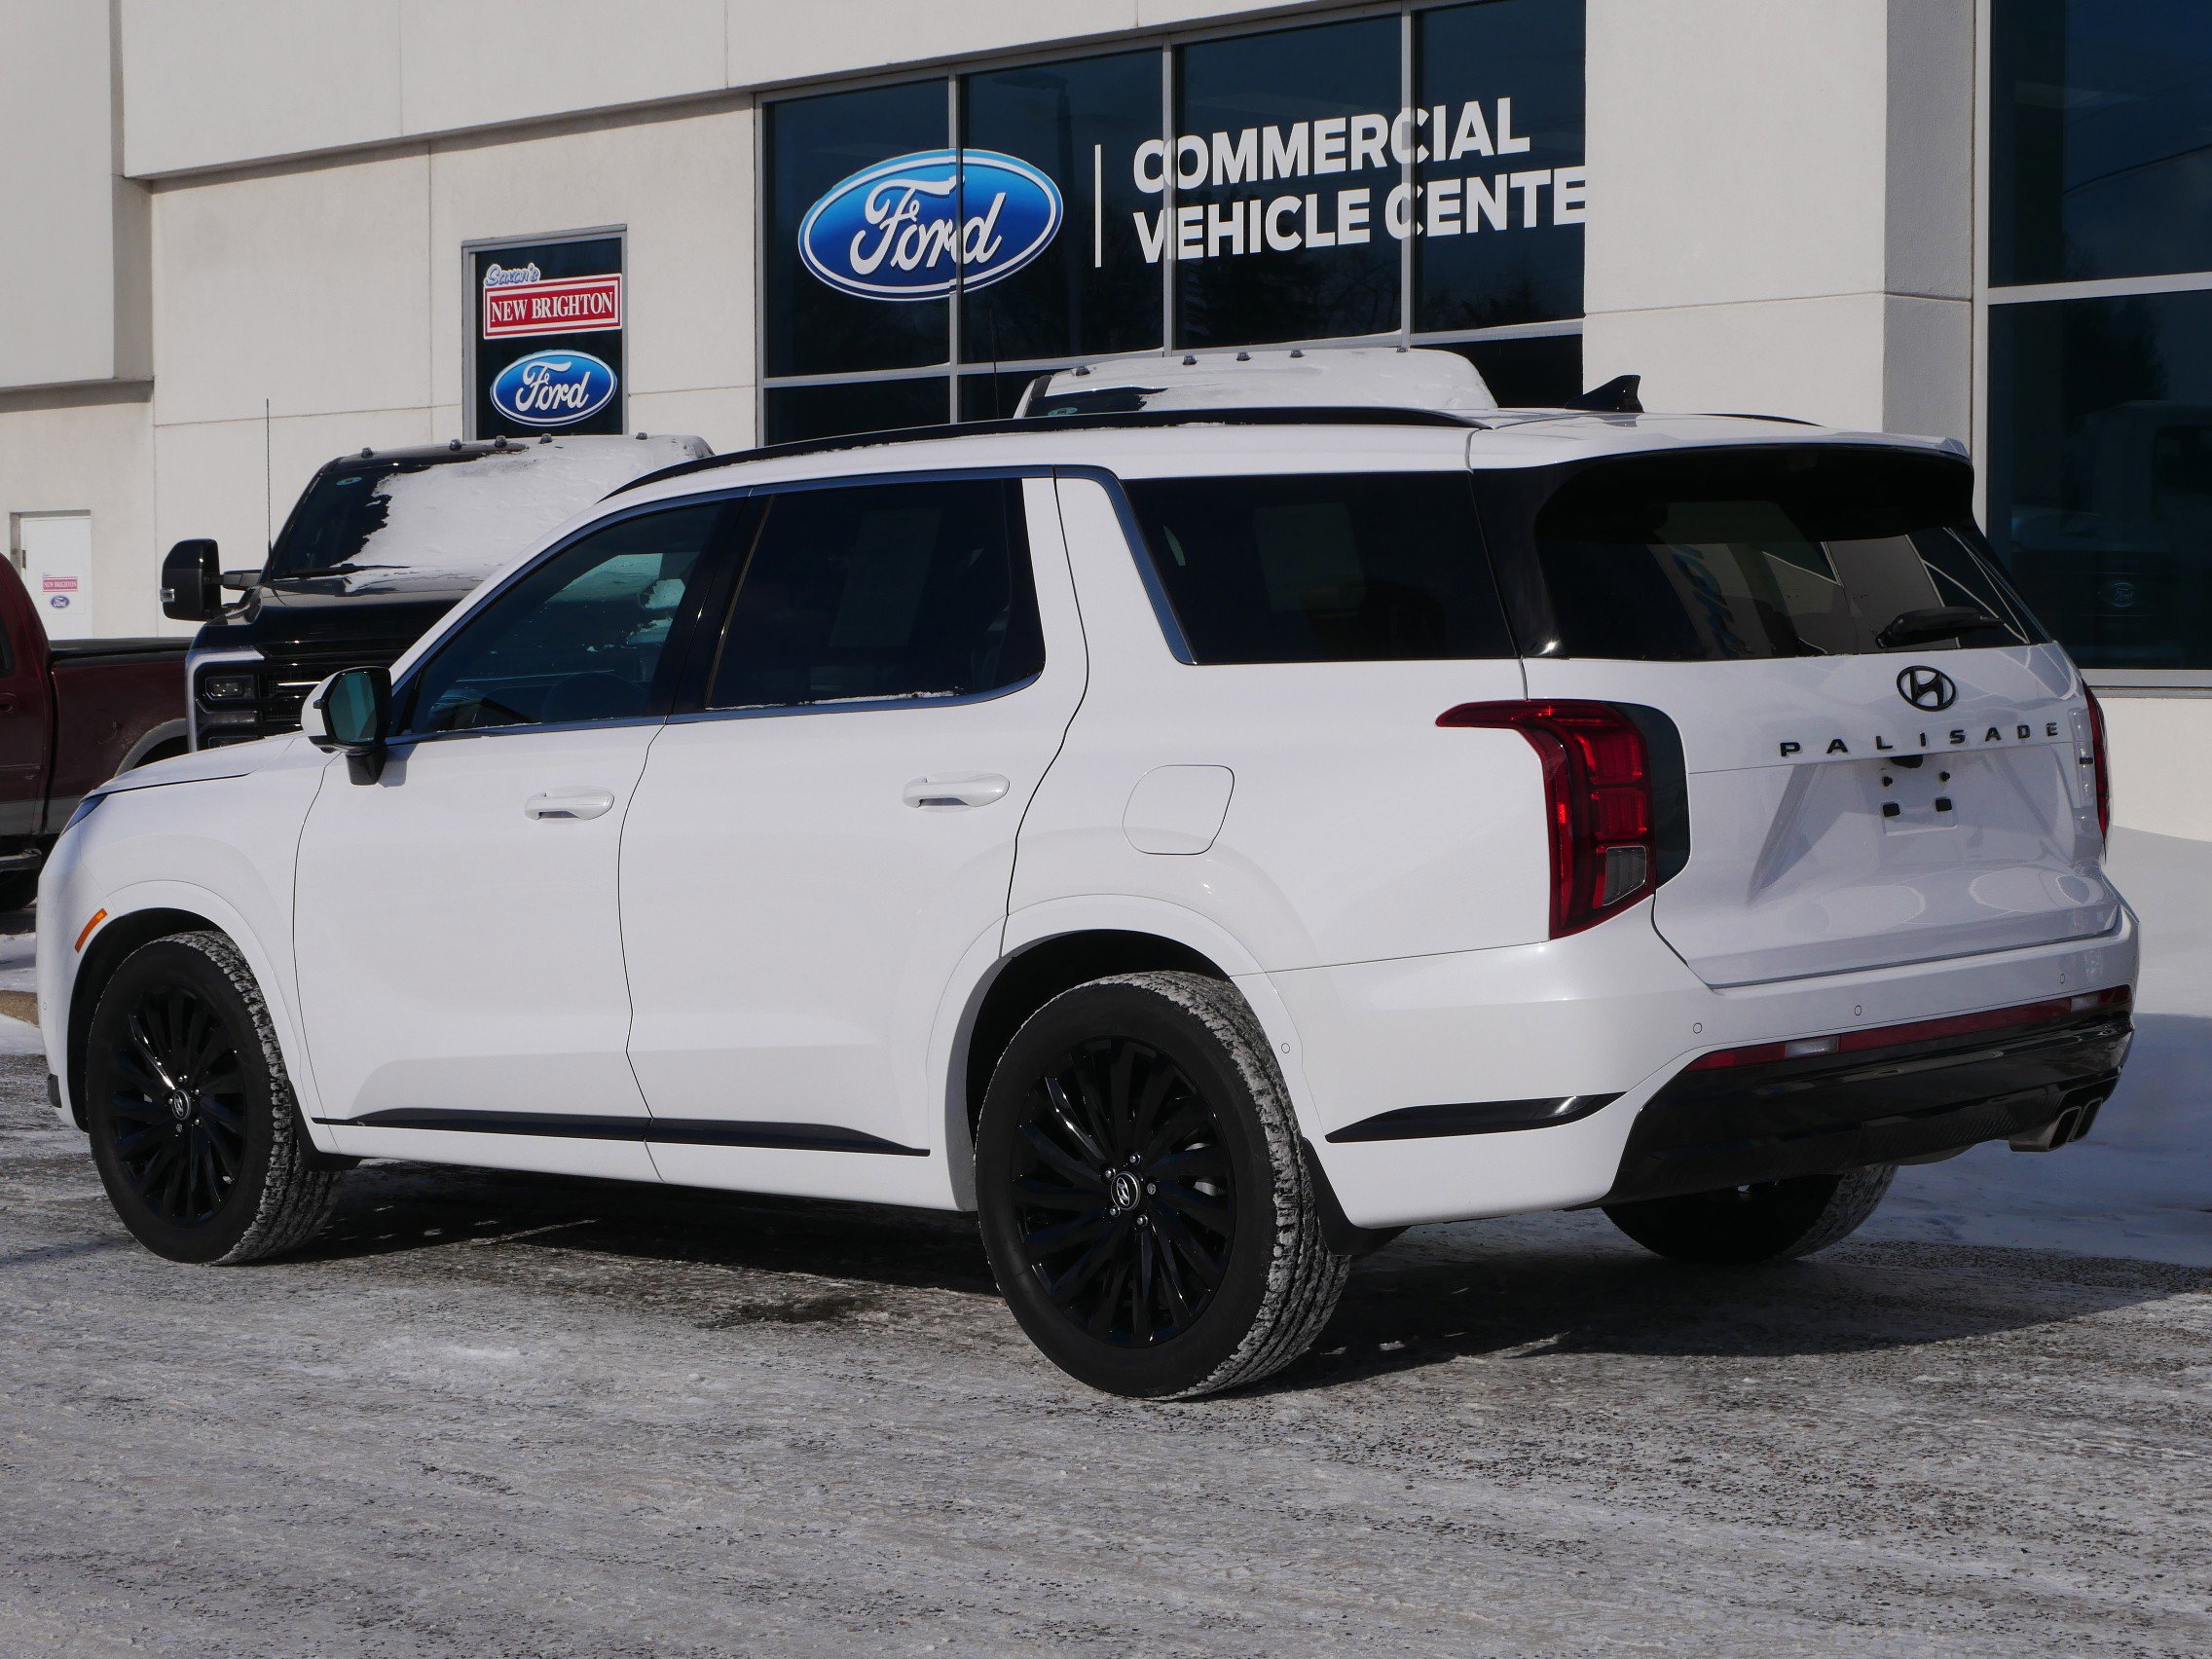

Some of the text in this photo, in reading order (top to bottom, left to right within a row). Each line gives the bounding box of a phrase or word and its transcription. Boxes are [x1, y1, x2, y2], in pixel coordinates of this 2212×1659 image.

[1133, 97, 1530, 194] COMMERCIAL
[850, 174, 1006, 275] Ford
[1133, 188, 1370, 264] VEHICLE
[486, 265, 539, 286] Saxon's
[491, 292, 613, 322] NEW BRIGHTON
[515, 361, 591, 412] Ford
[1780, 721, 2059, 757] PALISADE
